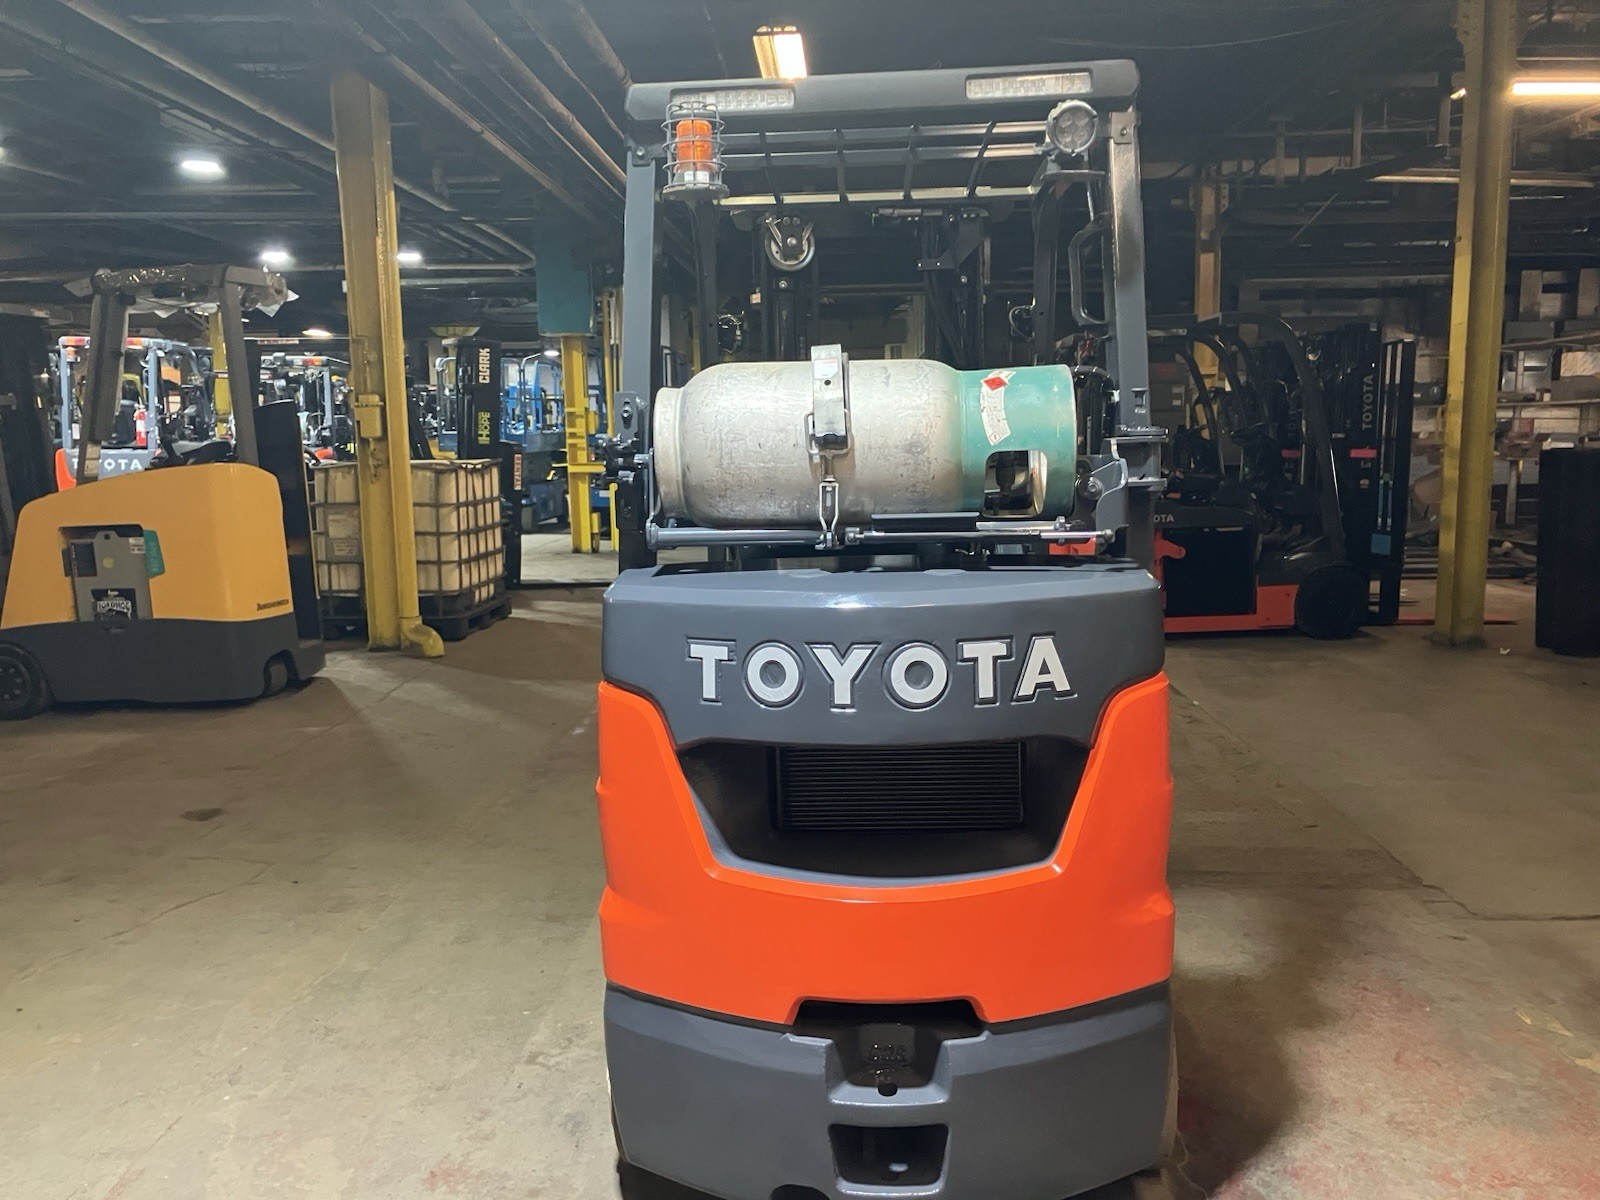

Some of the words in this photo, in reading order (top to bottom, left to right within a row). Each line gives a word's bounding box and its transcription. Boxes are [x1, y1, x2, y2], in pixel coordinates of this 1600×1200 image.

[479, 348, 490, 384] CLARK
[1362, 375, 1374, 431] TOYOTA
[72, 458, 143, 471] TOTA
[688, 637, 1073, 706] TOYOTA
